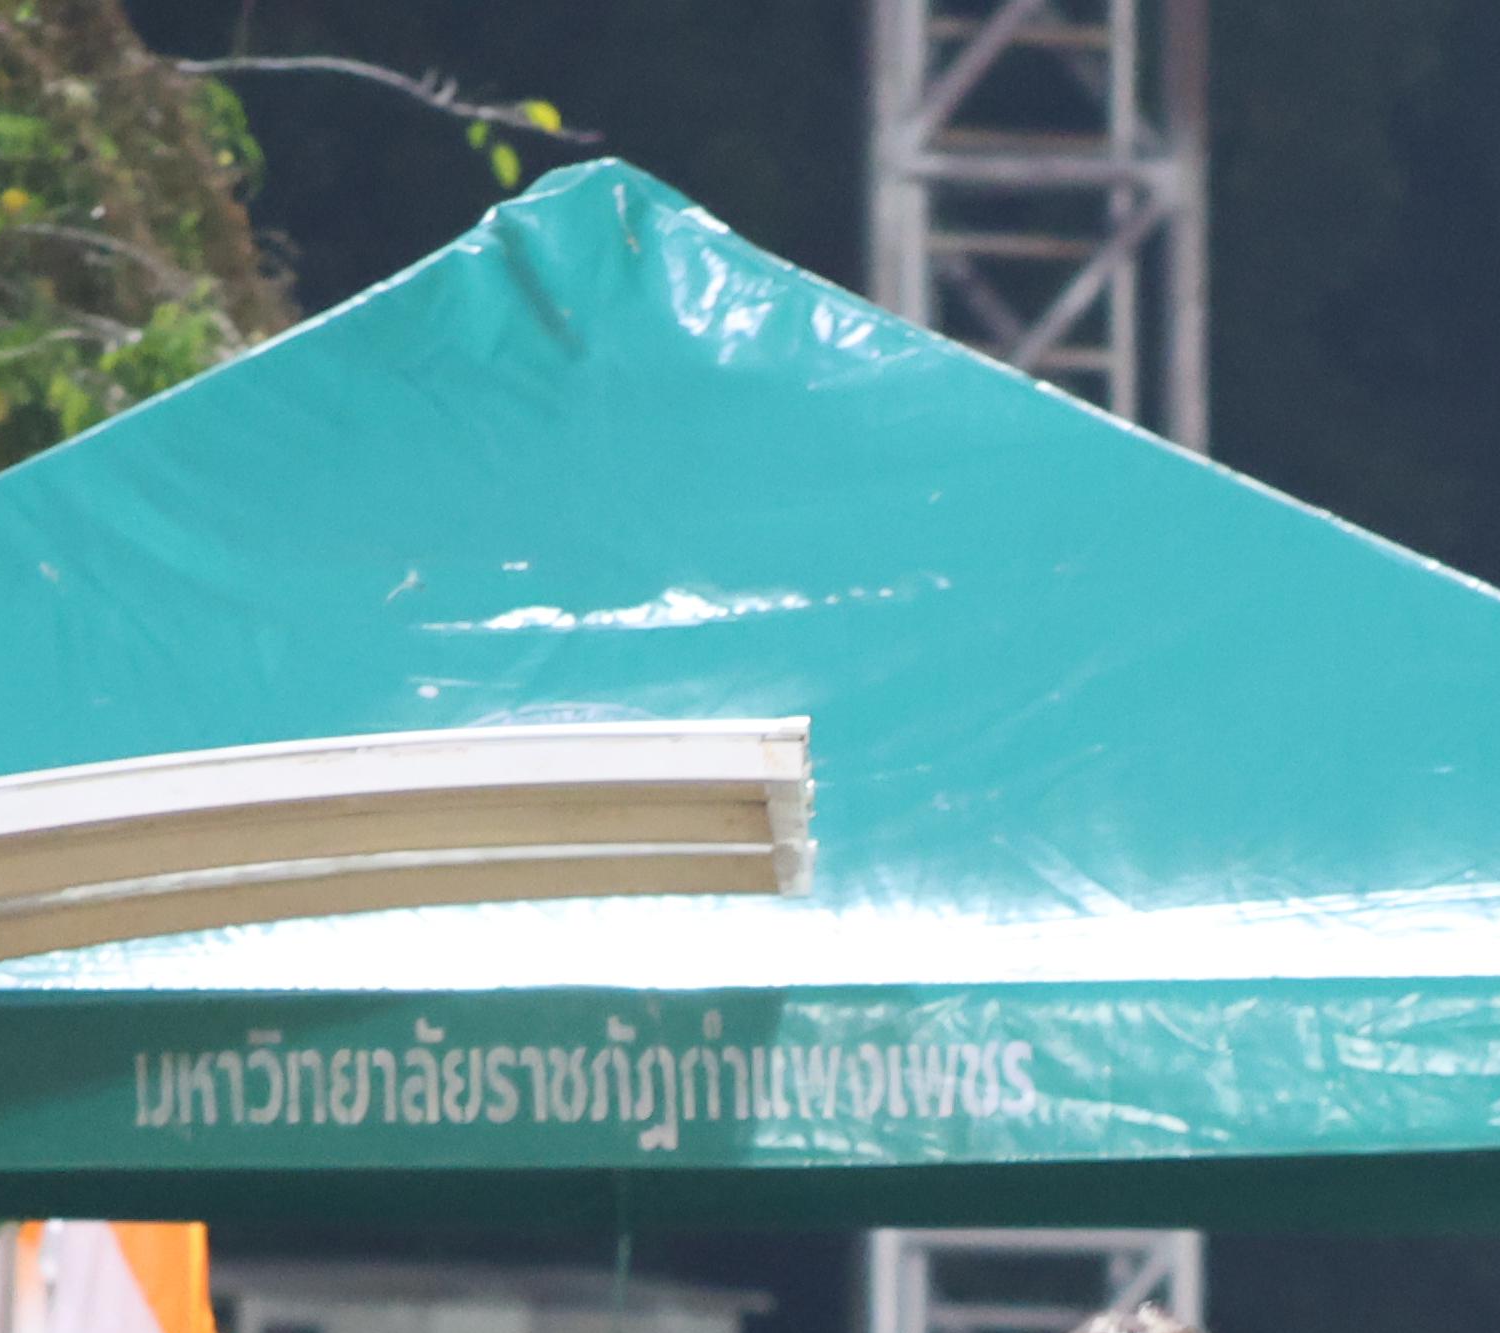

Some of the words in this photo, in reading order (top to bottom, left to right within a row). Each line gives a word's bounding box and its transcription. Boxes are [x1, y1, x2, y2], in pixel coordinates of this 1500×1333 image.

[134, 1007, 1038, 1152] มหาวิทยาลัยราชภัฏกำแพงเพชร
